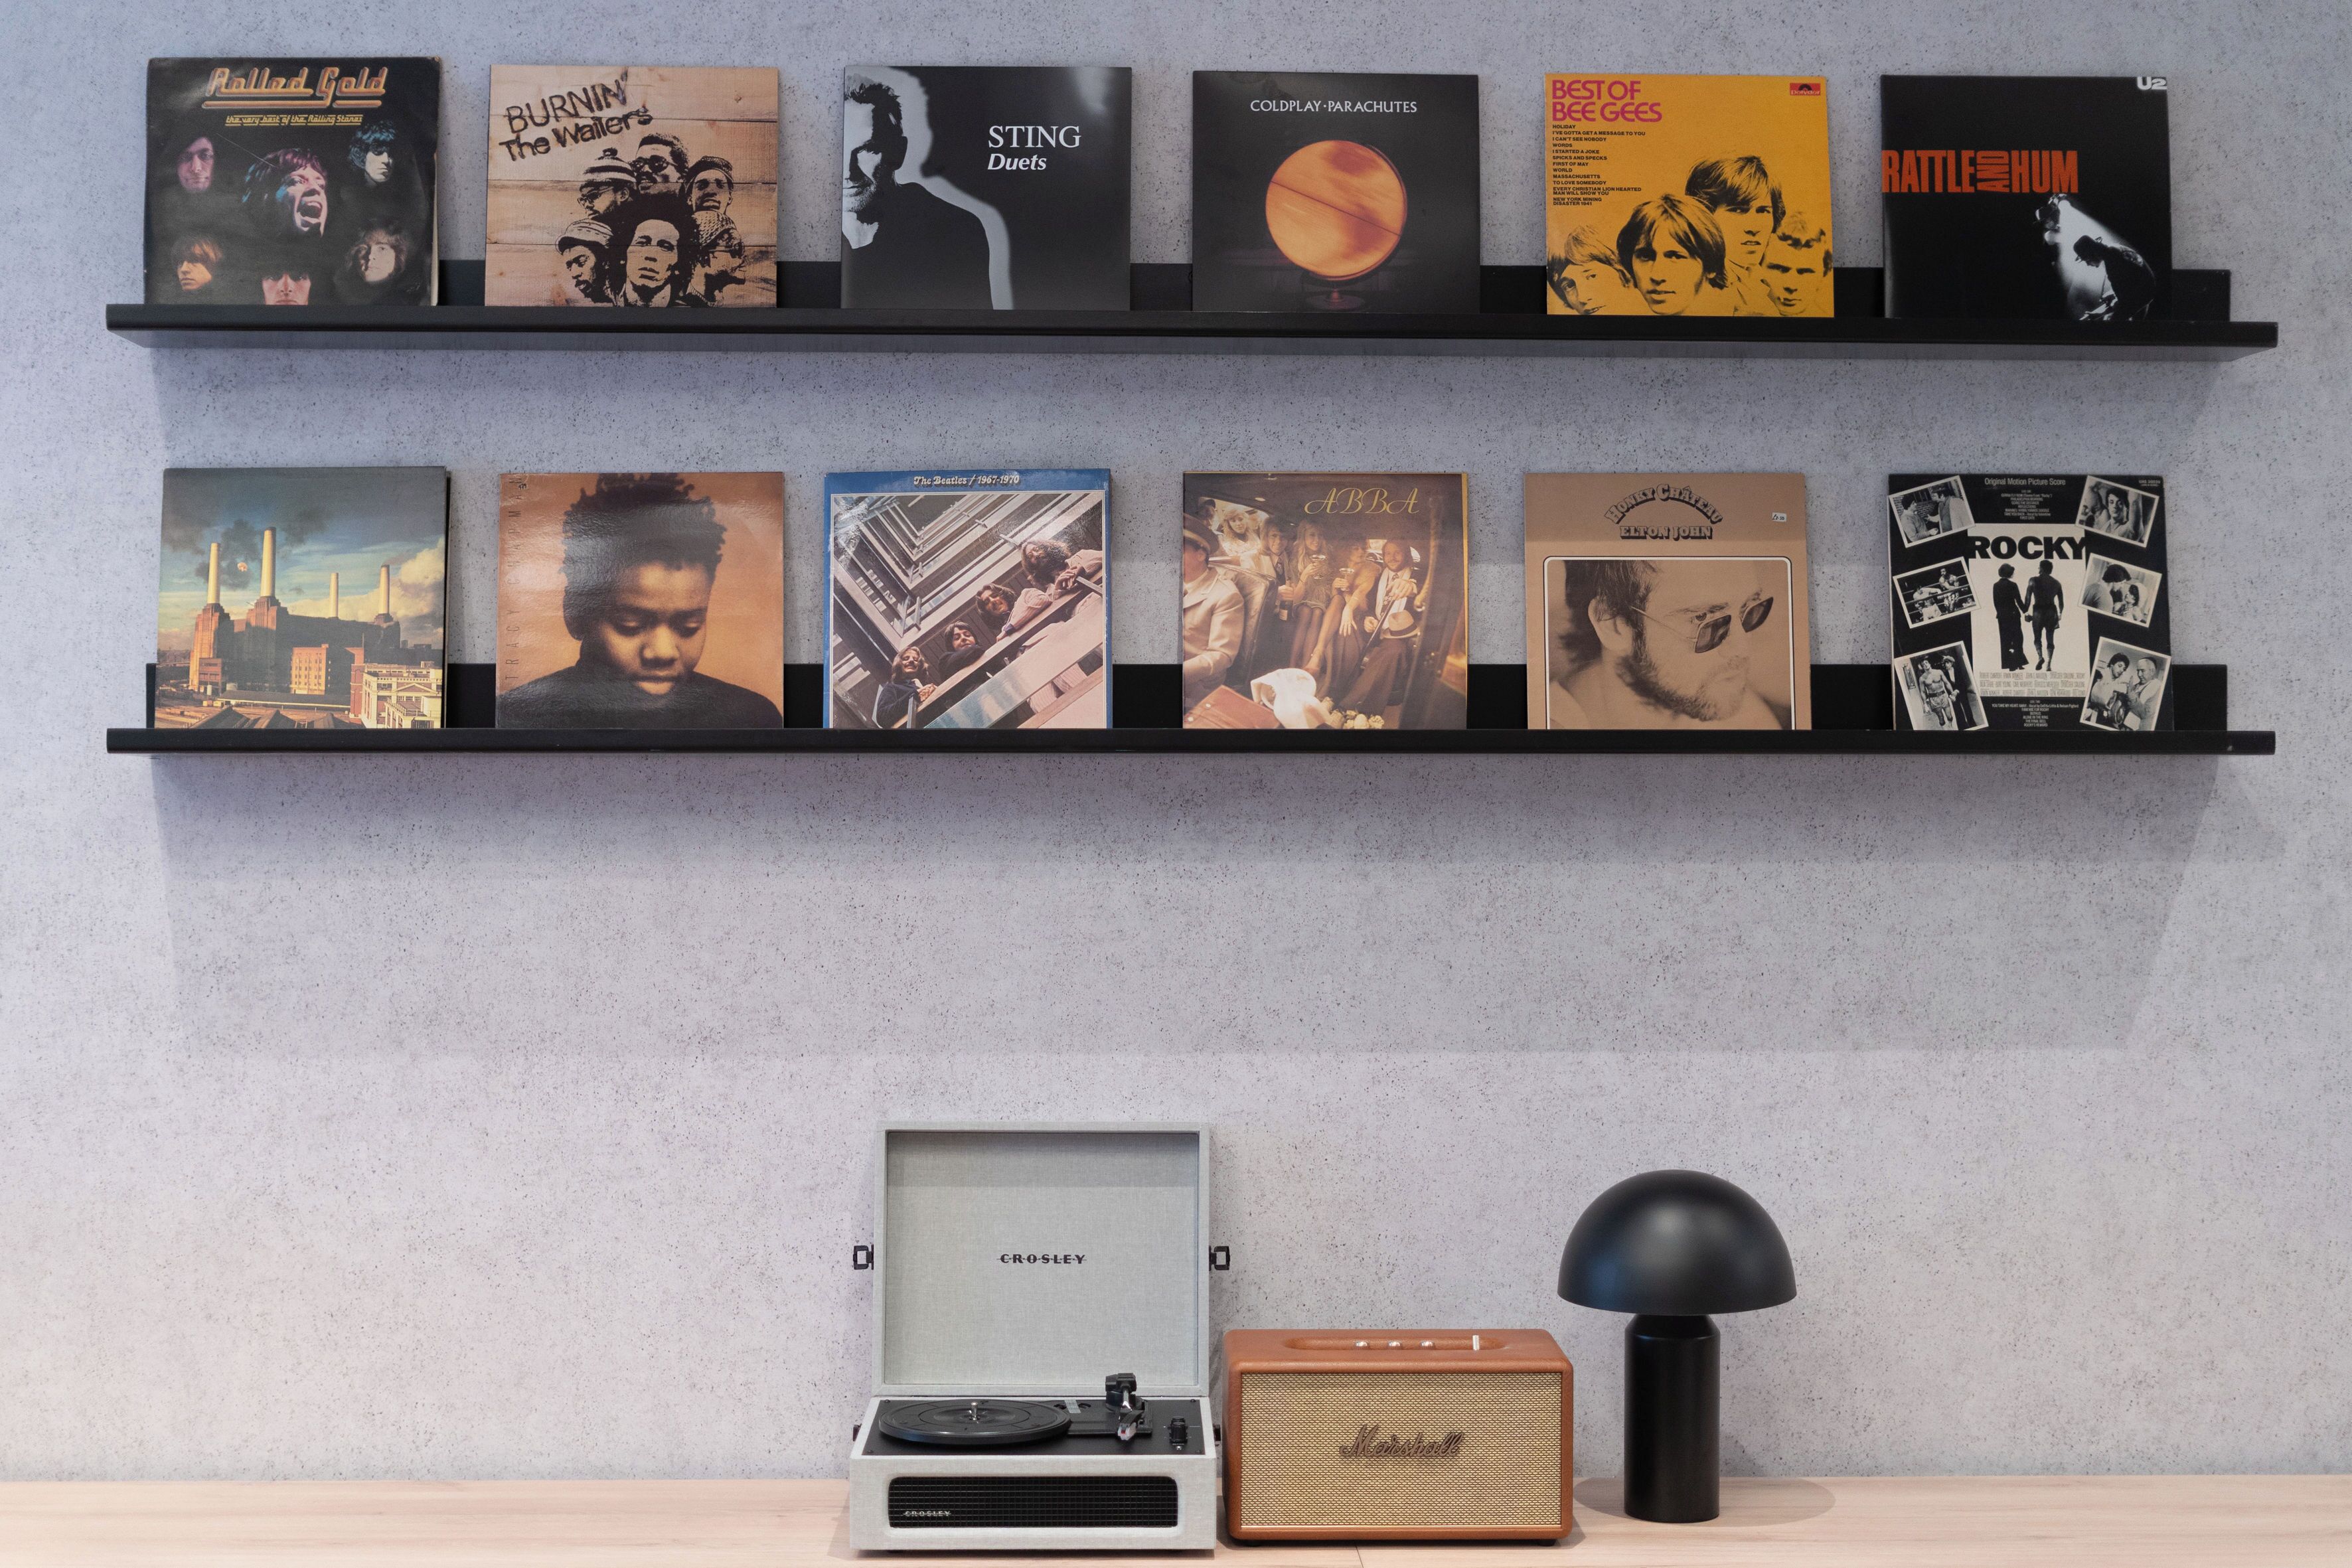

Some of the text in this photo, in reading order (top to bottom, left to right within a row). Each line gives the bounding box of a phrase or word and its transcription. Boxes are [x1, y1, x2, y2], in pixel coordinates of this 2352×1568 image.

[203, 67, 388, 109] Rolled Gold
[1552, 79, 1641, 101] BEST OF
[2137, 76, 2167, 90] U2
[1250, 100, 1418, 113] COLDPLAY PARACHUTES
[1552, 101, 1662, 123] BEE GEES
[226, 115, 363, 125] the very best of the Rolling Stones
[499, 106, 654, 161] The Wailers
[987, 125, 1082, 149] STING
[987, 153, 1047, 171] Duets
[1881, 149, 2079, 194] RATTLE AND HUM
[913, 476, 932, 487] The
[933, 475, 967, 487] Beatles
[978, 475, 1021, 485] 1967-1970
[1985, 478, 2006, 486] Original
[1304, 487, 1420, 514] ABBA
[1603, 487, 1656, 524] HONKY
[1620, 525, 1713, 541] ELTON JOHN
[1967, 535, 2086, 560] ROCKY
[505, 609, 520, 680] TRACY
[998, 1254, 1086, 1264] CROSLEY
[1340, 1425, 1464, 1456] Marshall
